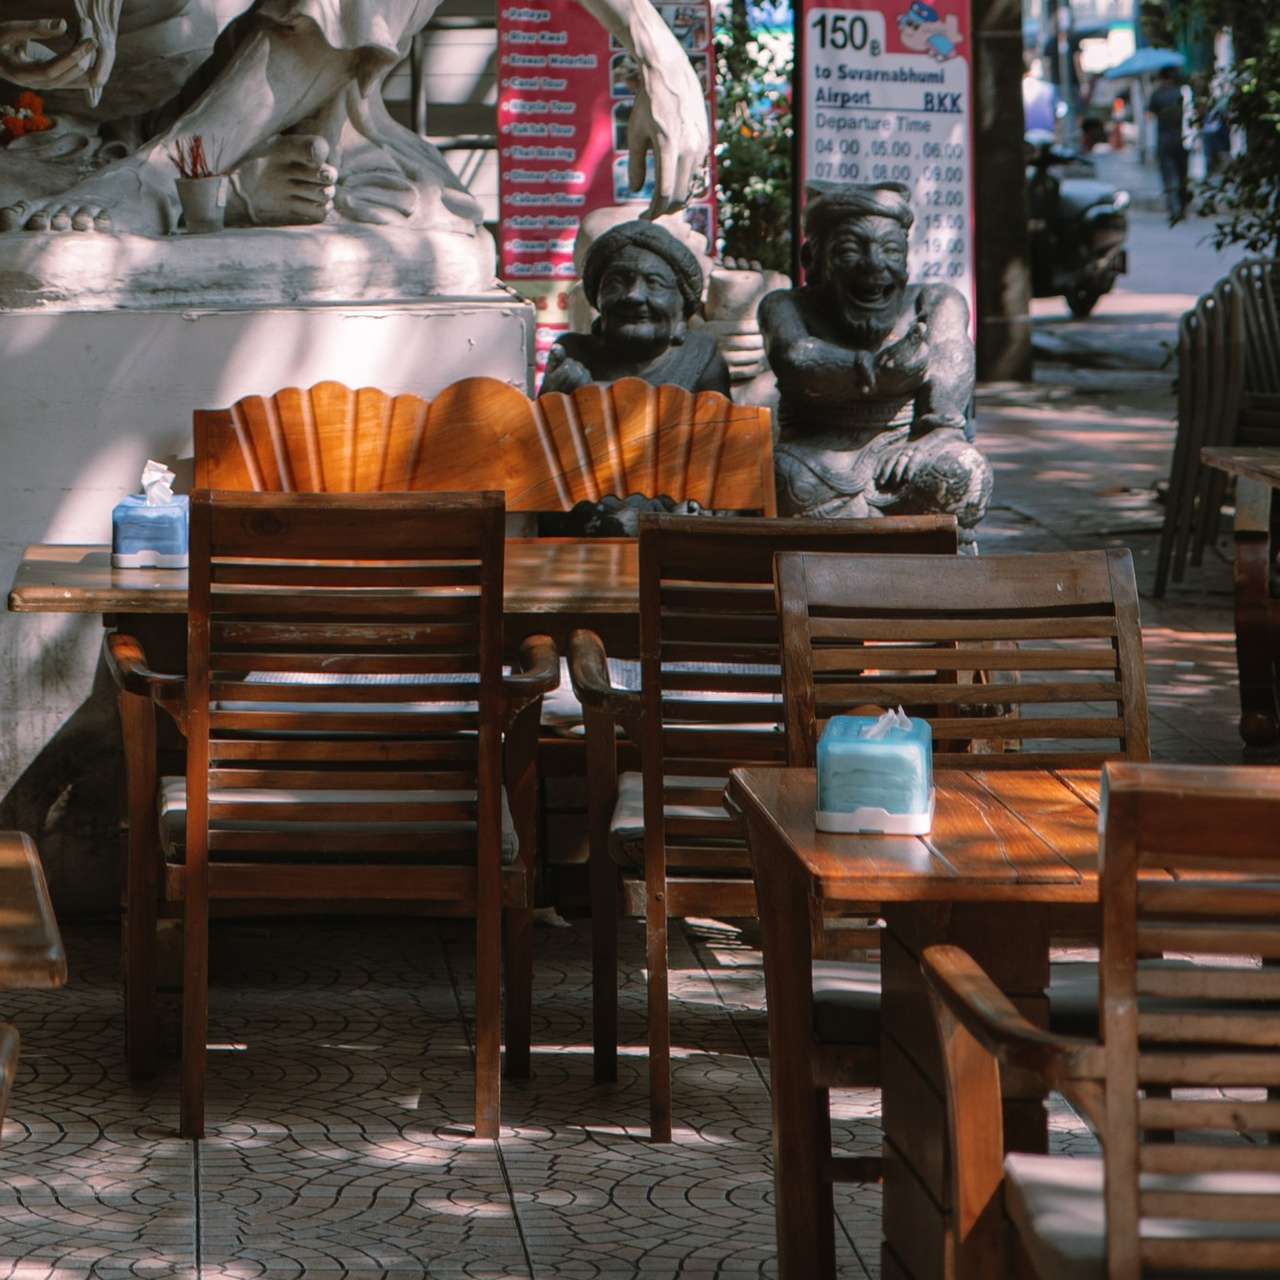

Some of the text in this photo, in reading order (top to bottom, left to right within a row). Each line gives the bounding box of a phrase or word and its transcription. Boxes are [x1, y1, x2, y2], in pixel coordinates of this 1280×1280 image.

[812, 13, 868, 50] 150
[815, 64, 945, 83] to Suvarnabhumi
[815, 88, 962, 113] Airport BKK
[815, 112, 932, 133] Departure Time
